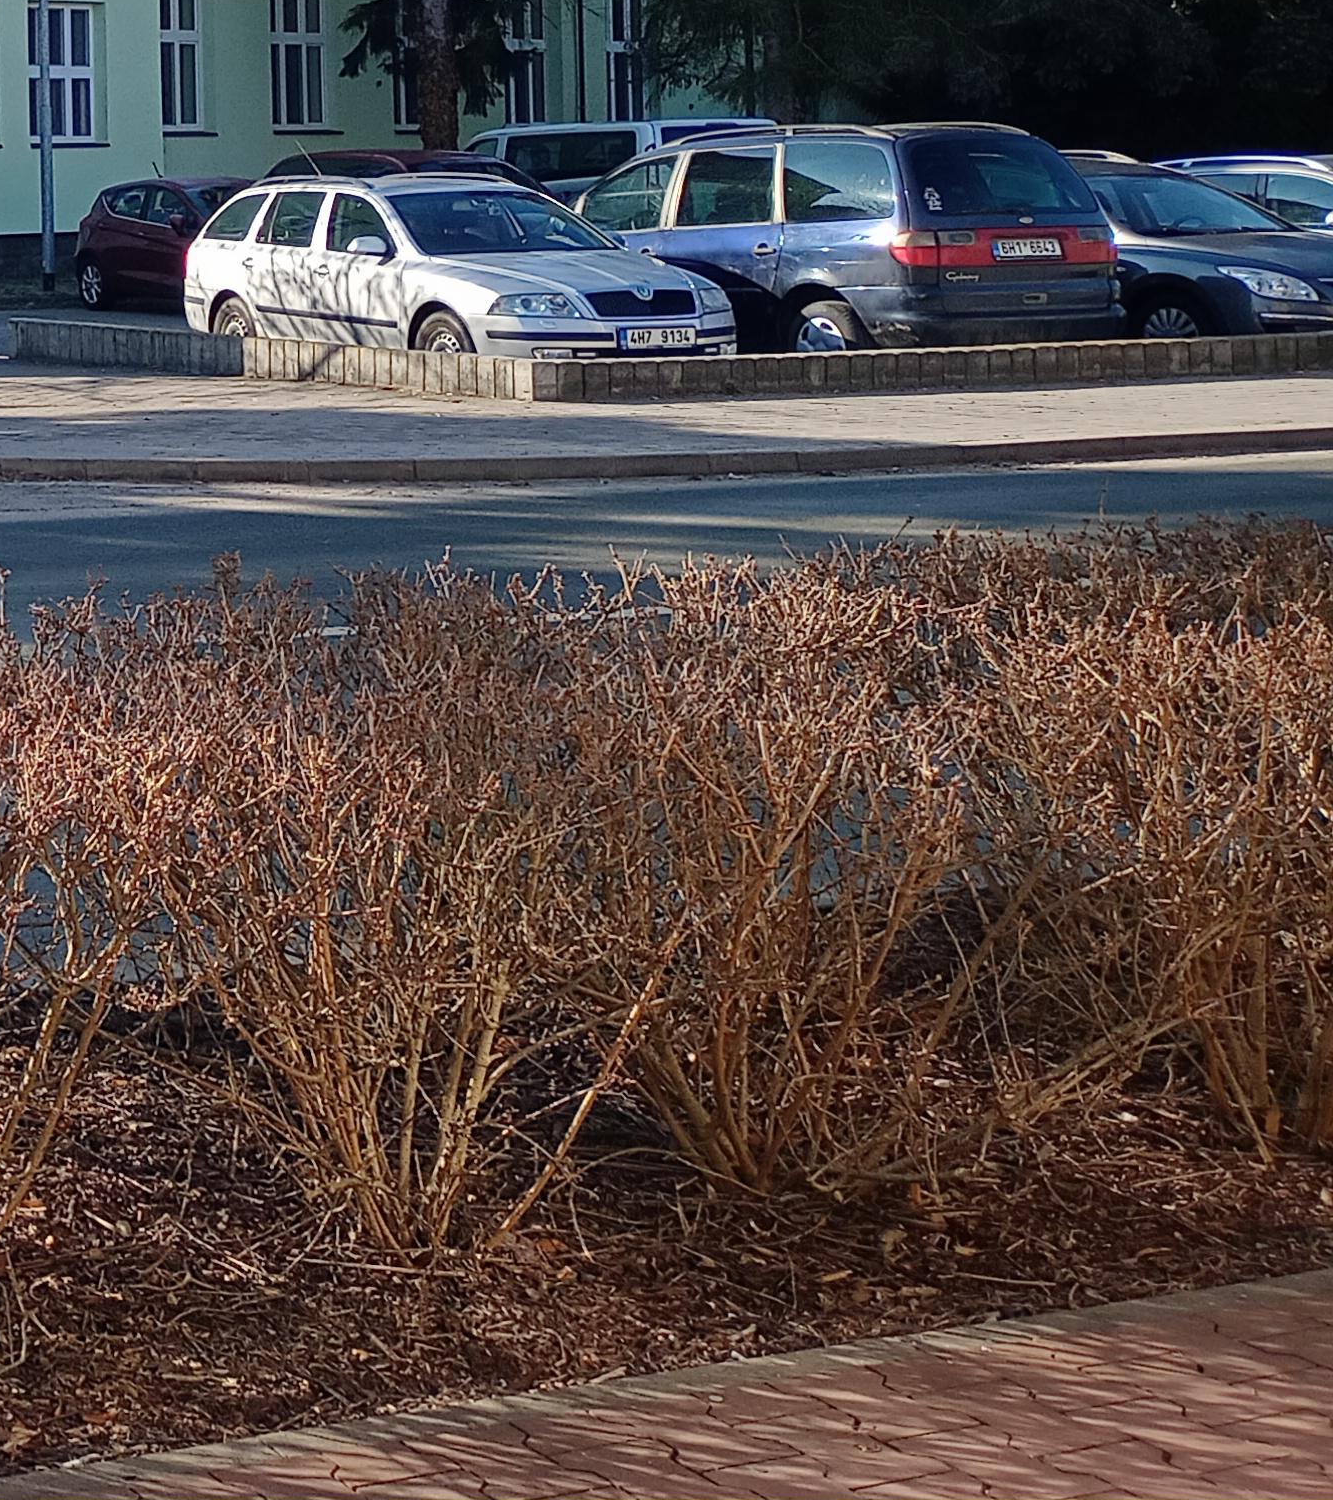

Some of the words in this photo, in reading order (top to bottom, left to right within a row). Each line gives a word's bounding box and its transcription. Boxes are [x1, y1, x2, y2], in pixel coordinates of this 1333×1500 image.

[1001, 241, 1023, 254] 6H1
[631, 331, 652, 344] 4H7
[661, 330, 690, 343] 9134
